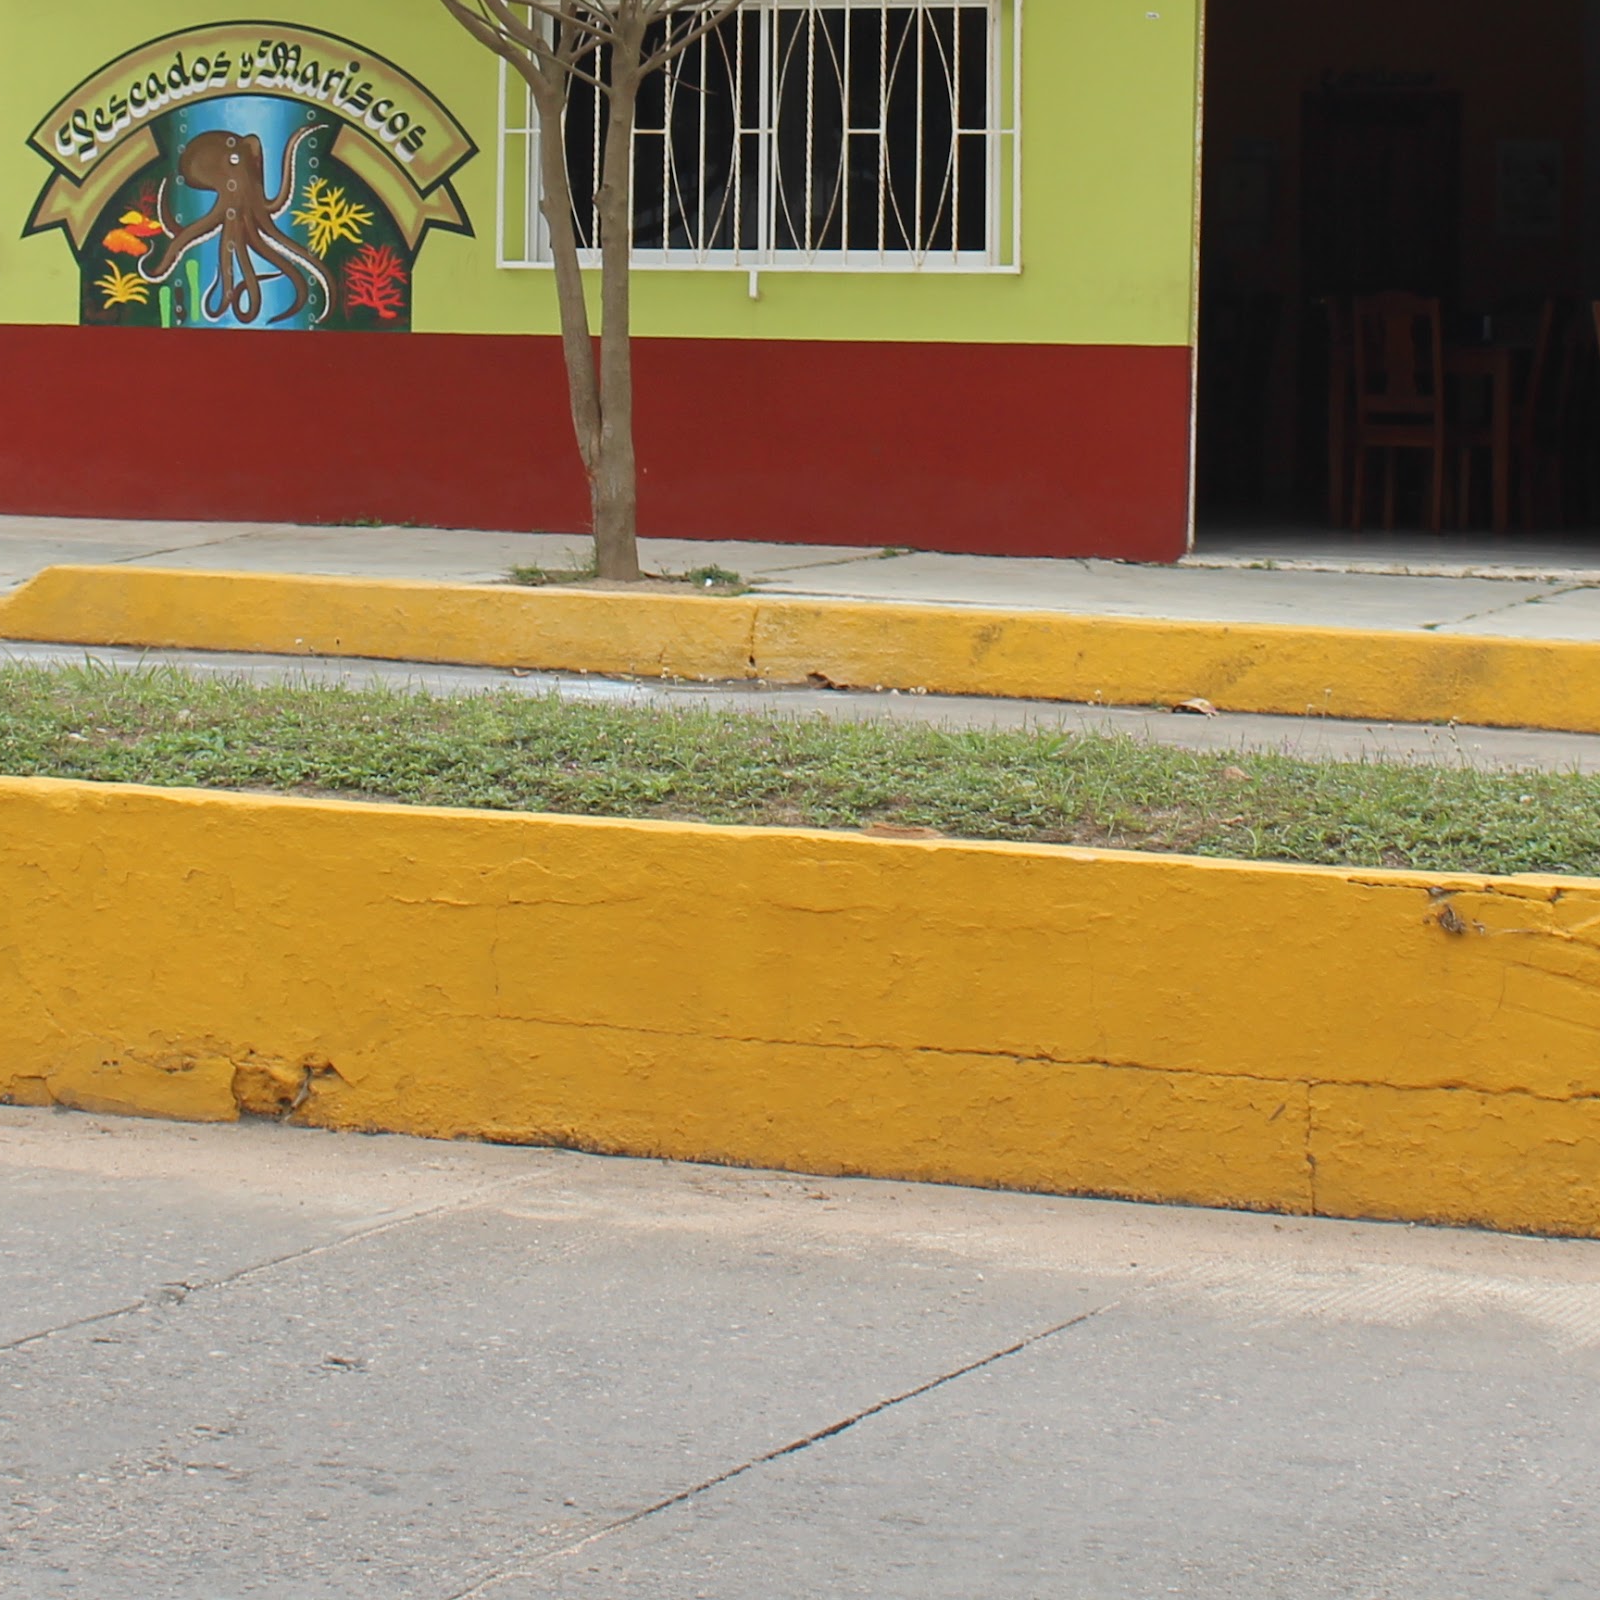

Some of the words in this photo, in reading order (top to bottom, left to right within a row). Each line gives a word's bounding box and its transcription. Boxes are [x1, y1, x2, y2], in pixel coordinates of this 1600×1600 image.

[56, 51, 231, 160] Pescados
[238, 52, 254, 84] y
[257, 40, 426, 160] Mariscos
